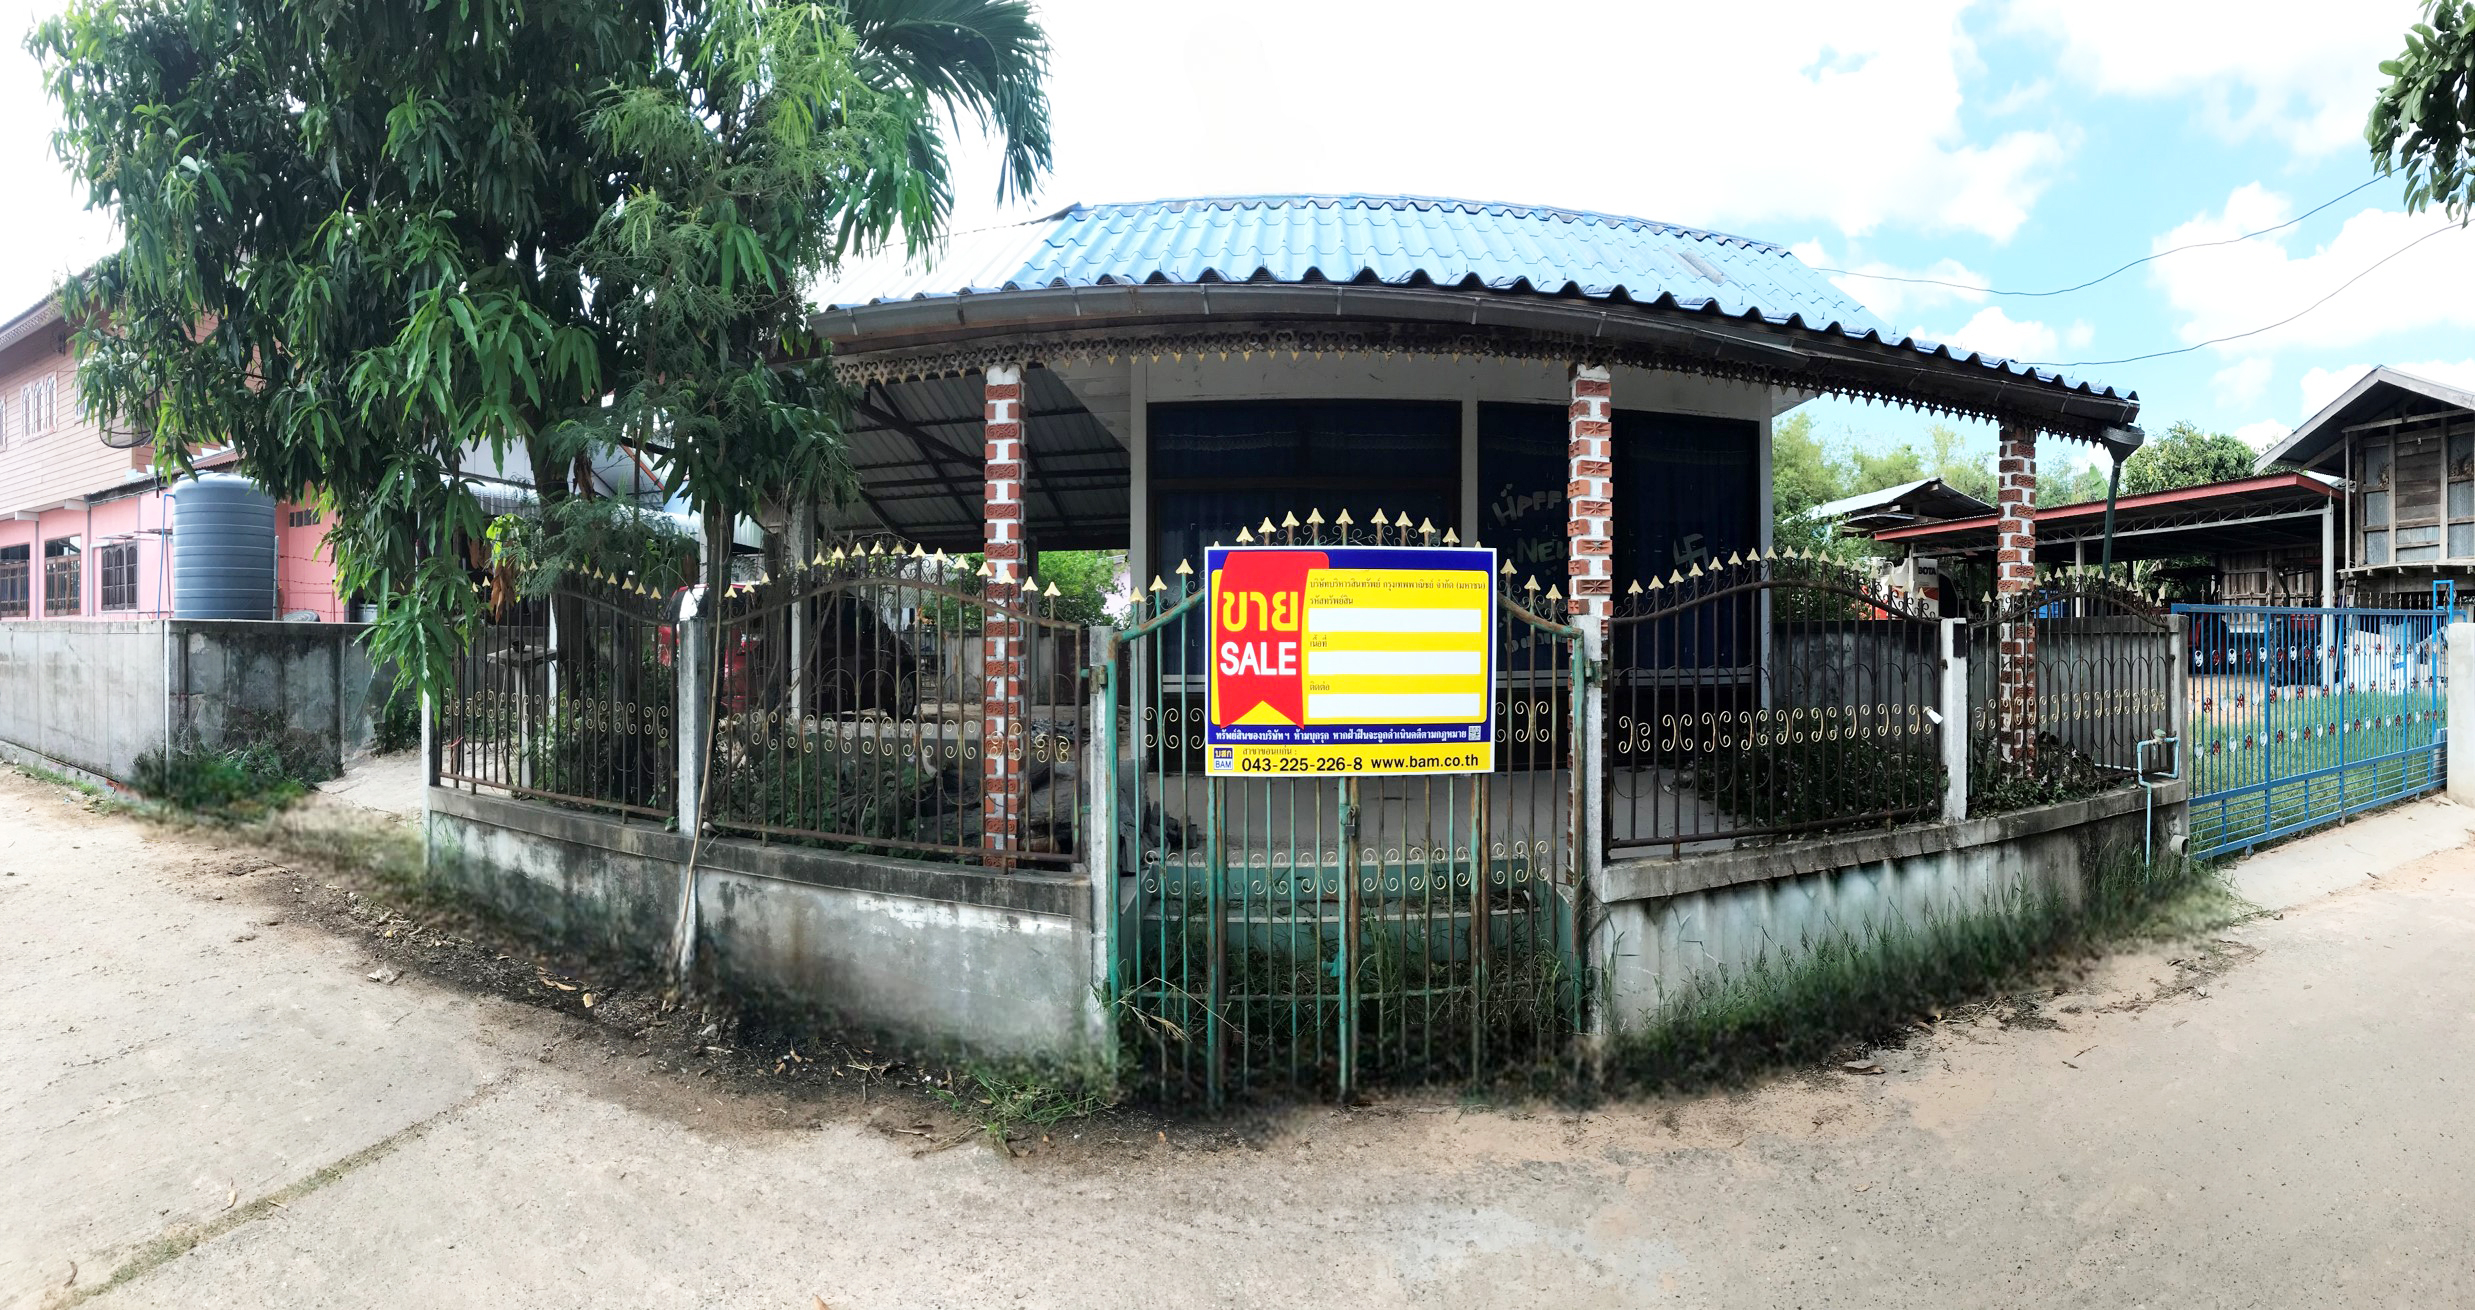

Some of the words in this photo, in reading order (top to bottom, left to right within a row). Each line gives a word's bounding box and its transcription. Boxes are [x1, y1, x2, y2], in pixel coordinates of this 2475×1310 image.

[1223, 591, 1299, 632] ขาย
[1220, 641, 1297, 676] SALE
[1215, 760, 1232, 769] BAM
[1242, 757, 1363, 772] 043-225-226-8
[1371, 754, 1479, 769] www.bam.co.th
